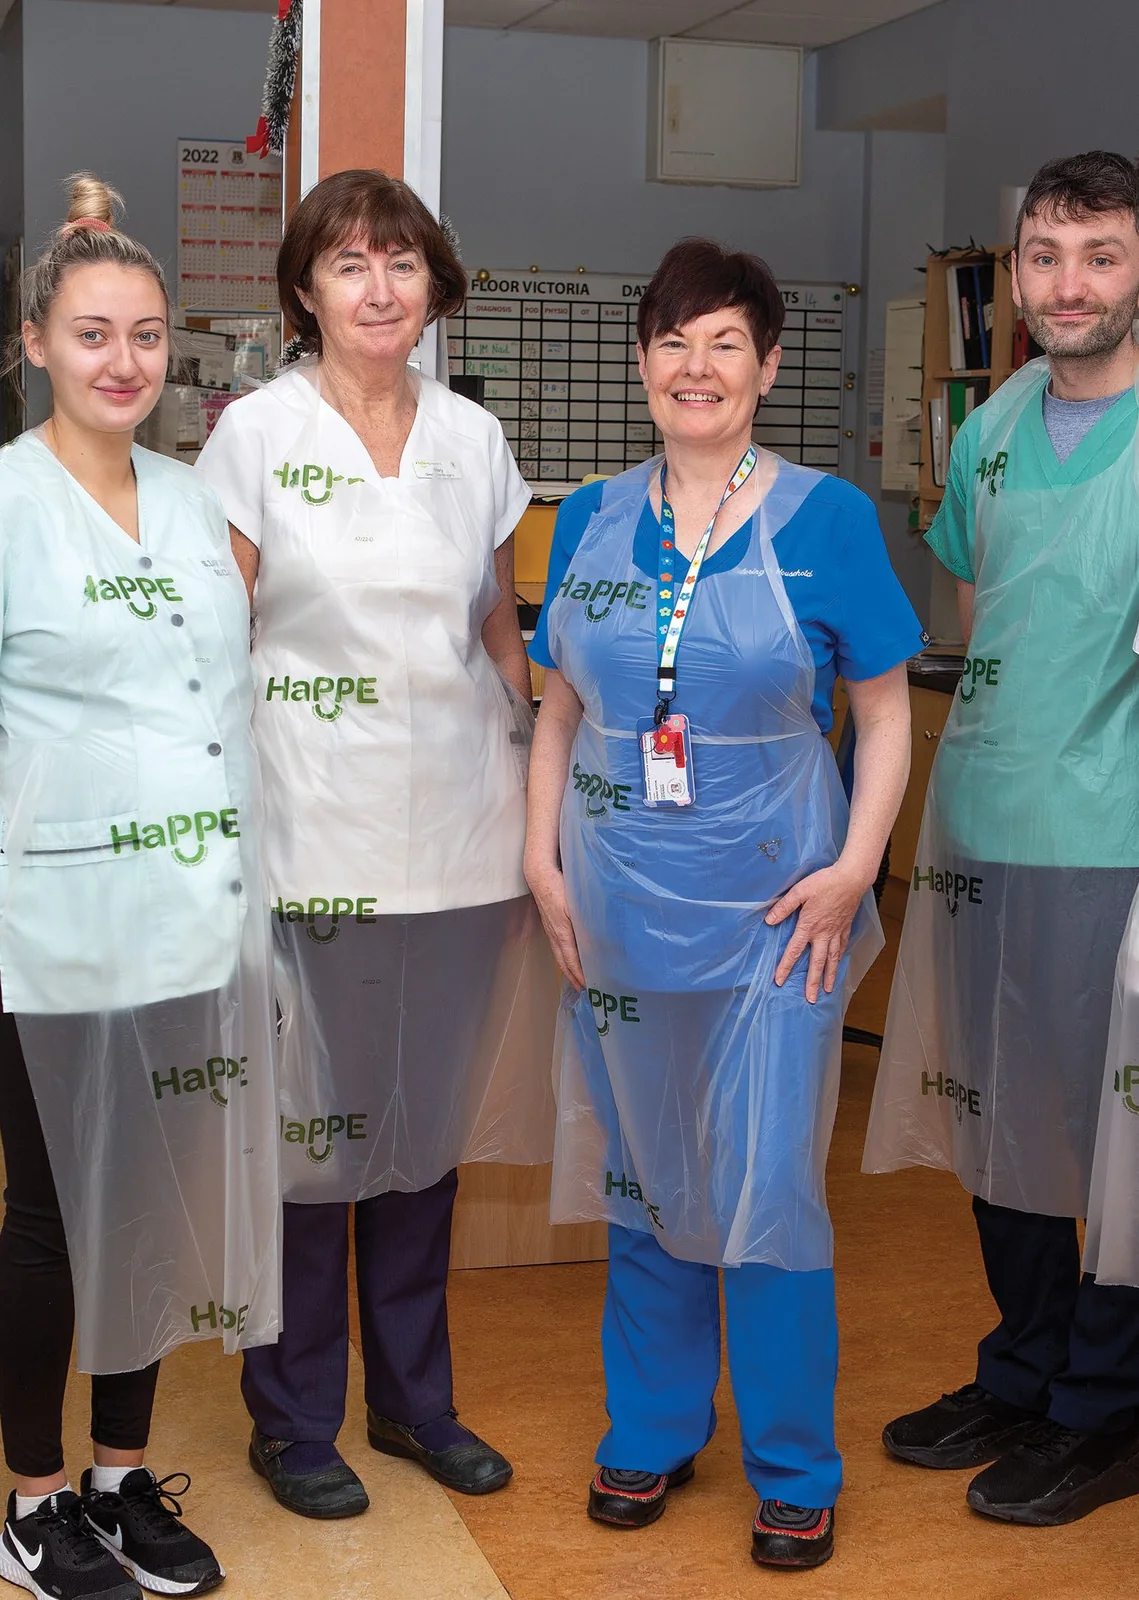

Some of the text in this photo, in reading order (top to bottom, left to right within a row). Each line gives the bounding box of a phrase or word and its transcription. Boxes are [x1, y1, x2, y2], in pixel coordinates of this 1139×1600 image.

[182, 149, 219, 163] 2022
[471, 279, 648, 297] FLOOR VICTORIA DAT
[963, 657, 1002, 686] PPE
[266, 676, 379, 703] HaPPE
[110, 808, 241, 854] HaPPE
[913, 865, 984, 905] HaPPE
[588, 988, 641, 1023] PPE
[280, 1113, 368, 1145] aPPE
